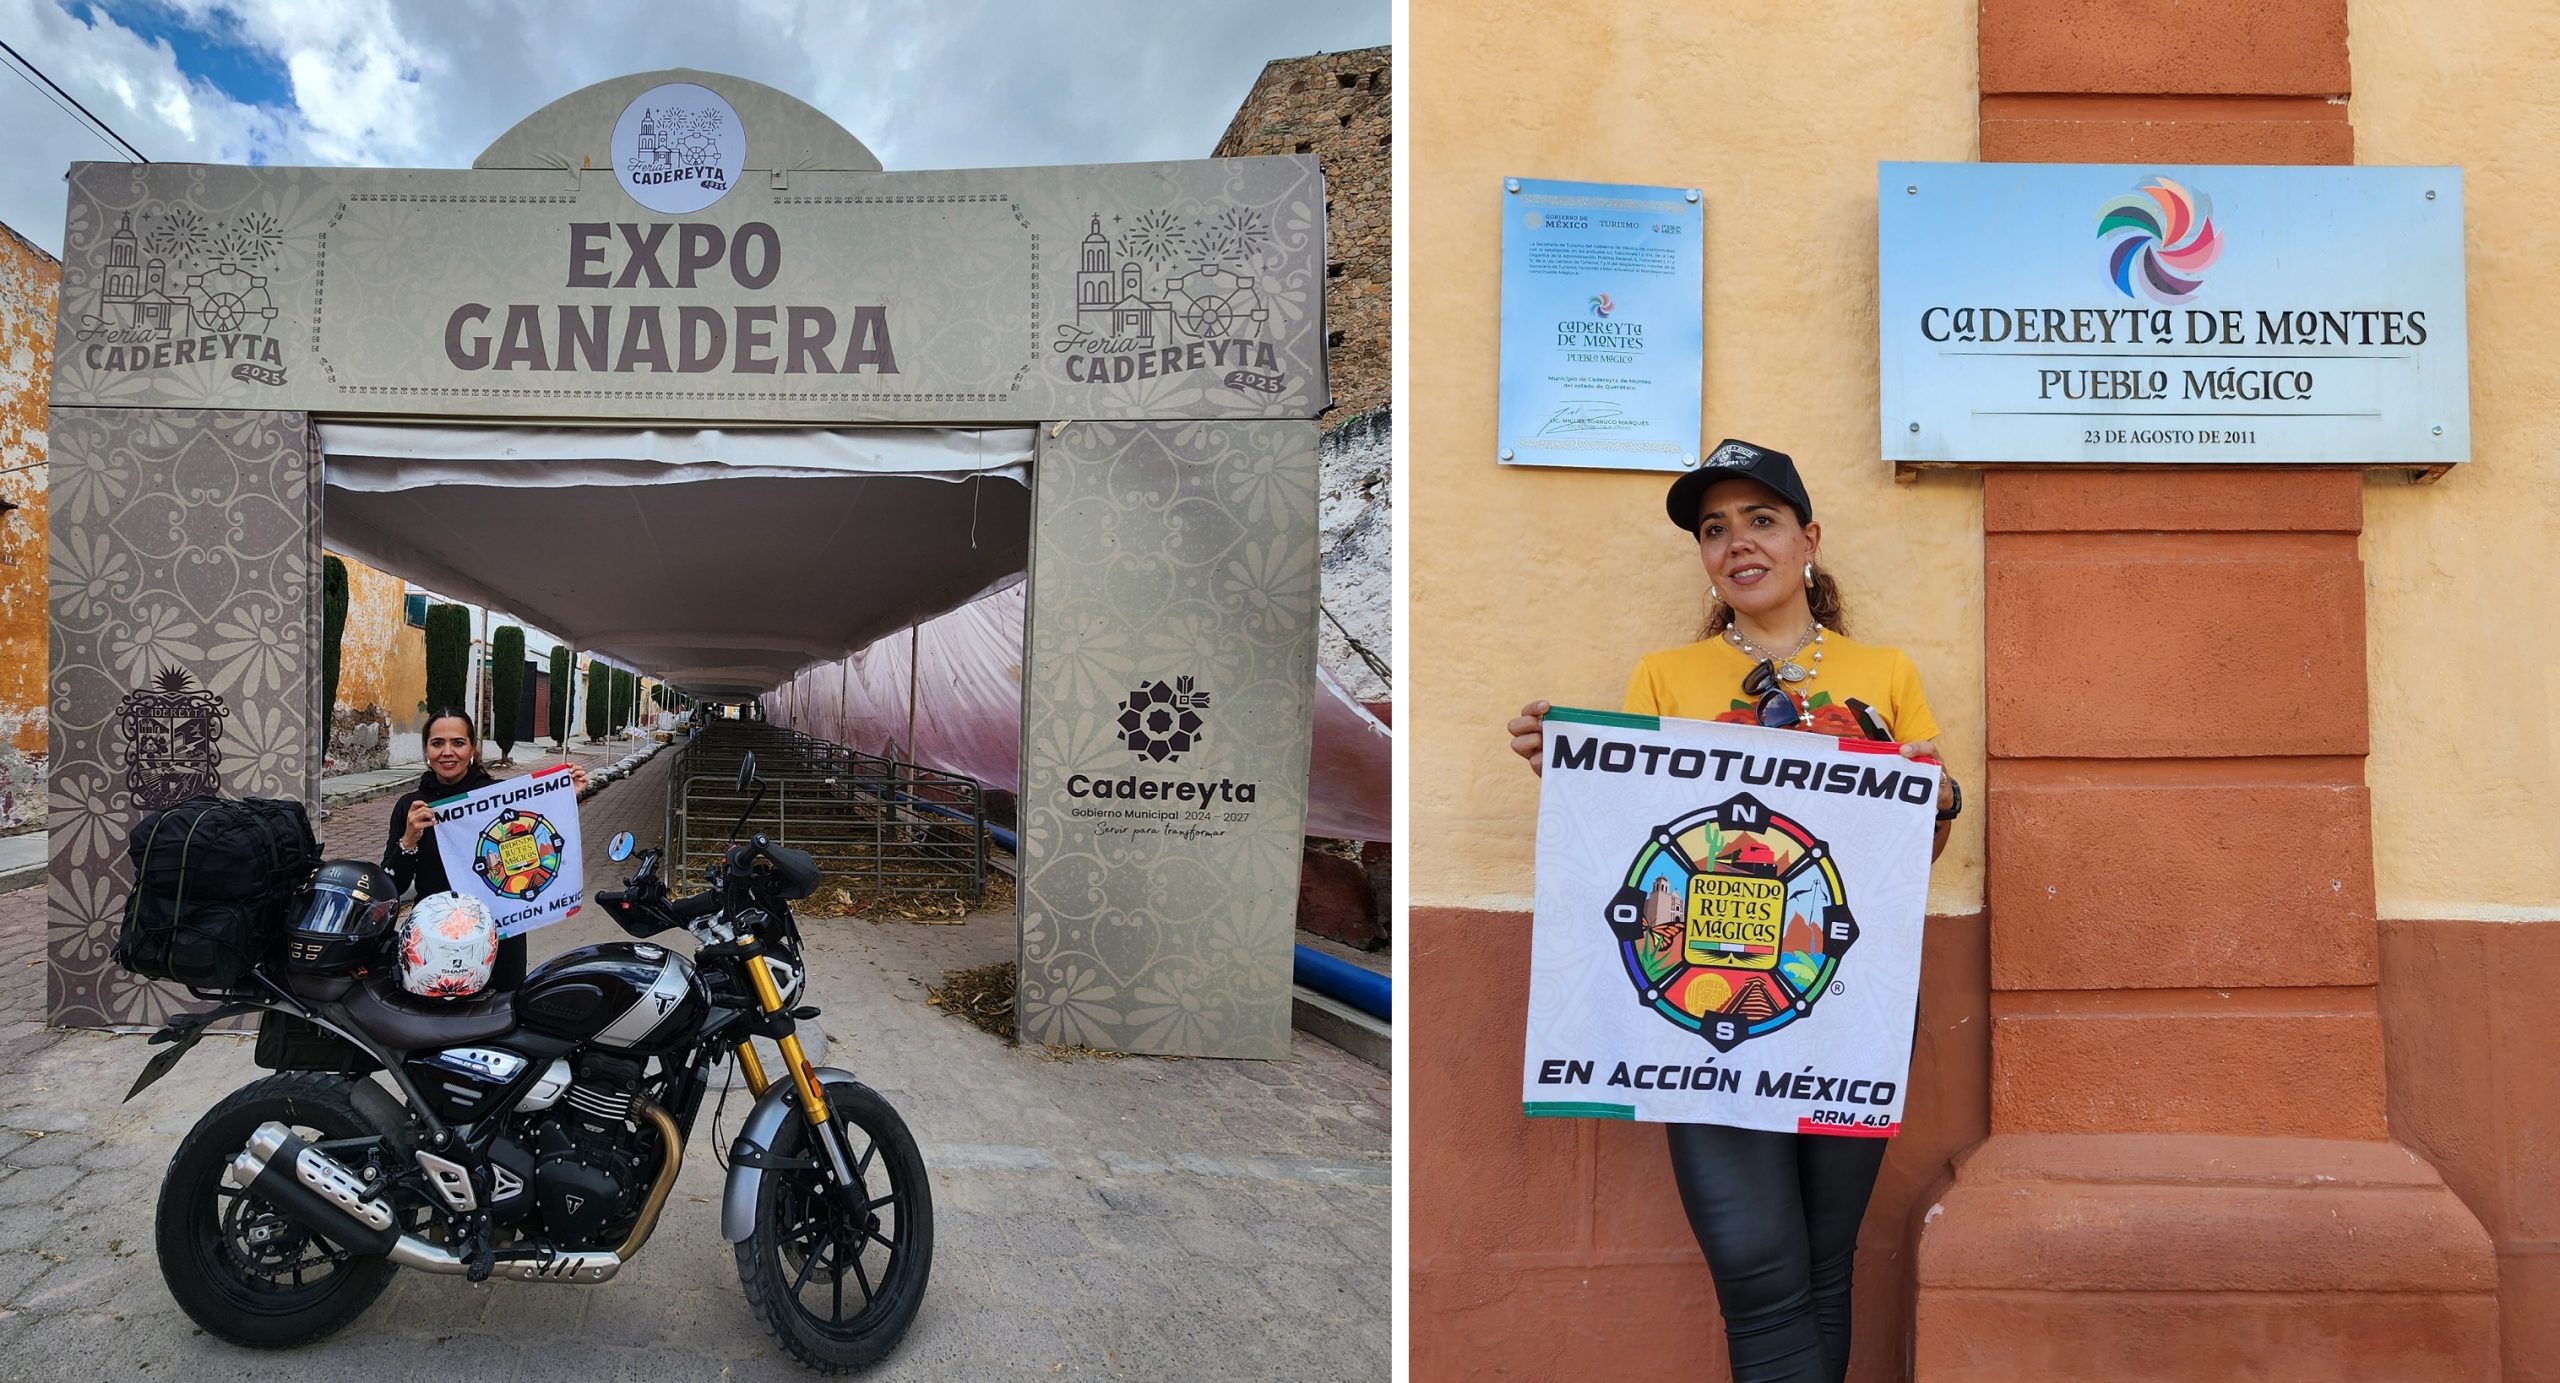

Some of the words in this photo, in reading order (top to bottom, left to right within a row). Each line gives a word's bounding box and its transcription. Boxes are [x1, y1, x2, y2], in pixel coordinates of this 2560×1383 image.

[627, 158, 664, 172] Feria
[632, 166, 725, 185] CADEREYTA
[1545, 220, 1588, 229] MÉXICO
[1600, 220, 1639, 229] TURISMO
[565, 221, 781, 290] EXPO
[76, 314, 157, 344] Feria
[2185, 310, 2245, 345] DE
[444, 302, 901, 374] GANADERA
[1053, 324, 1140, 354] Feria
[86, 333, 284, 372] CADEREYTA
[1065, 338, 1280, 384] CADEREYTA
[240, 365, 281, 385] 2025
[1234, 372, 1279, 392] 2025
[2084, 430, 2101, 444] 23
[2105, 430, 2127, 444] DE
[2128, 430, 2195, 444] AGOSTO
[2198, 430, 2220, 444] DE
[2224, 430, 2256, 444] 2011
[1552, 733, 1934, 806] MOTOTURISMO
[433, 775, 571, 825] MOTOTURISMO
[1067, 774, 1256, 810] Cadereyta
[1071, 808, 1122, 819] Gobierno
[1124, 809, 1179, 822] Municipal
[1184, 811, 1211, 821] 2024
[1223, 812, 1249, 822] 2027
[1731, 803, 1757, 823] N
[1094, 822, 1128, 836] Servir
[1131, 826, 1160, 842] para
[1164, 823, 1225, 841] transformar
[1613, 905, 1637, 923] O
[1830, 922, 1849, 941] E
[1716, 1022, 1735, 1041] S
[1538, 1059, 1595, 1085] EN
[1607, 1057, 1741, 1093] ACCIÓN
[1755, 1066, 1896, 1106] MÉXICO
[1812, 1110, 1855, 1126] RRM
[1862, 1113, 1891, 1127] 4.0
